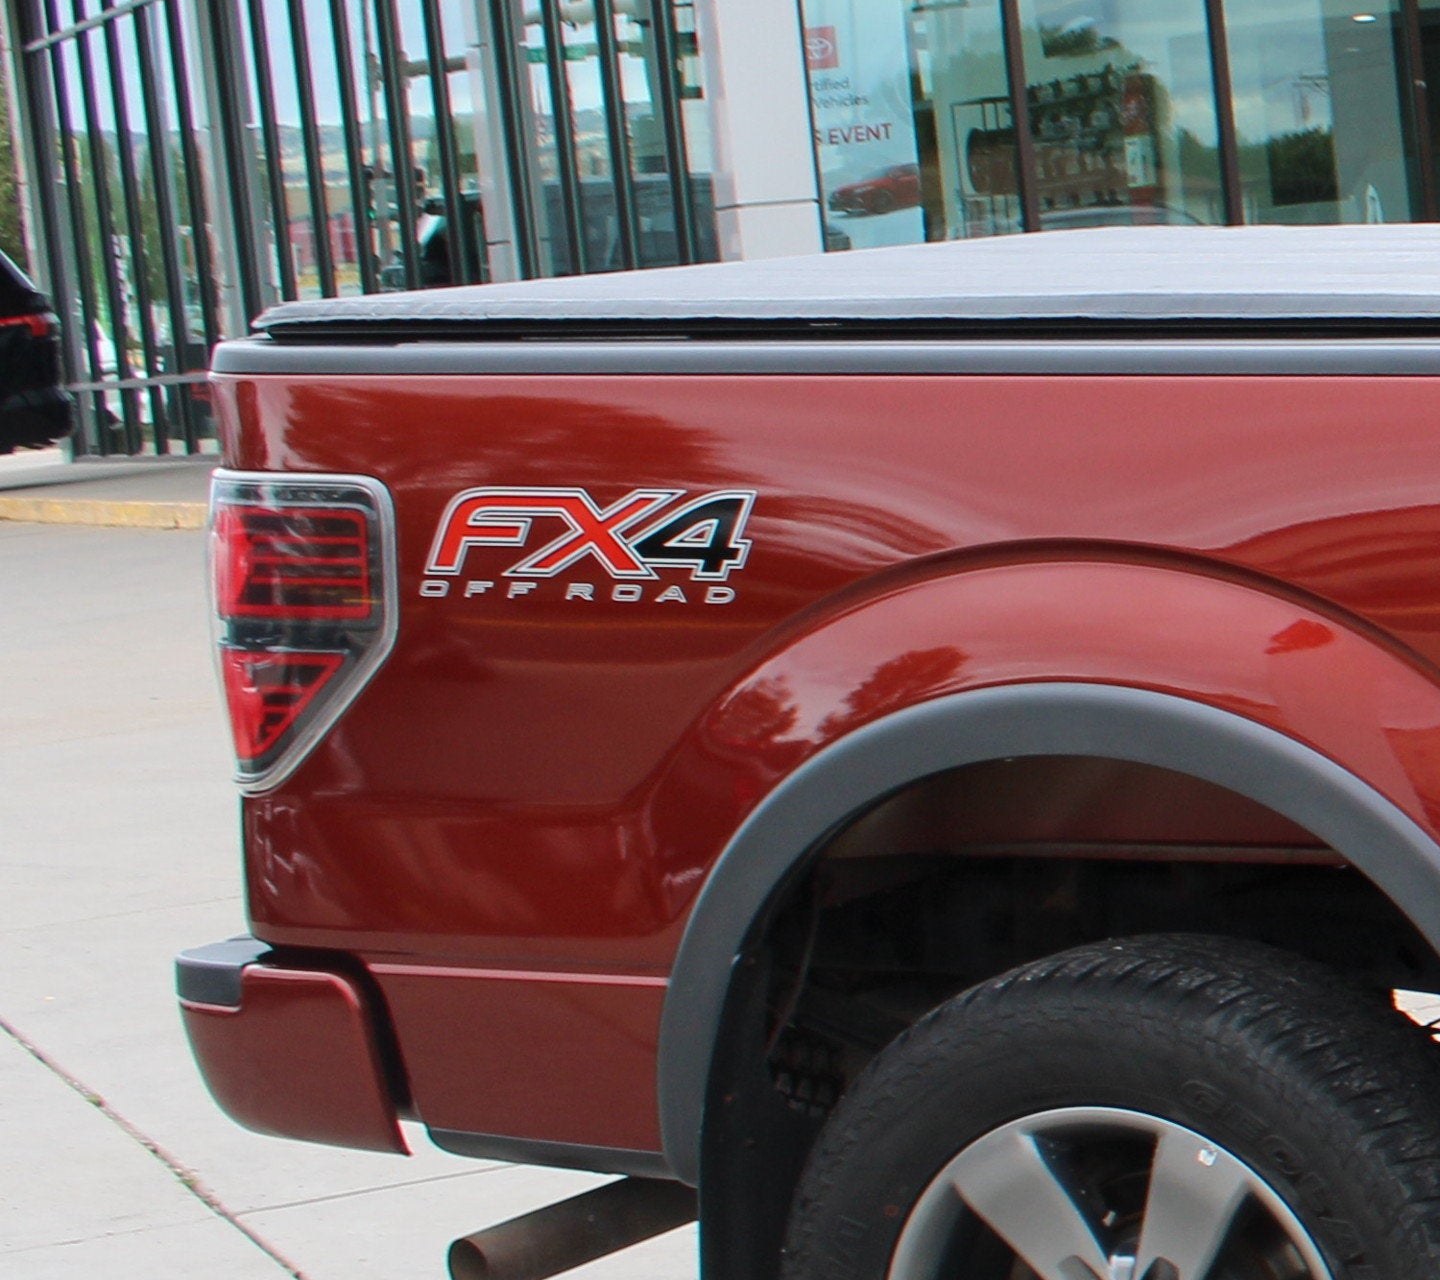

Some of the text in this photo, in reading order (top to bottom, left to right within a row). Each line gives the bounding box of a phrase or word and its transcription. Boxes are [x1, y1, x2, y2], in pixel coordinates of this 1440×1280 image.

[828, 122, 893, 146] EVENT
[424, 486, 757, 581] FX4
[419, 579, 737, 605] OFF ROAD
